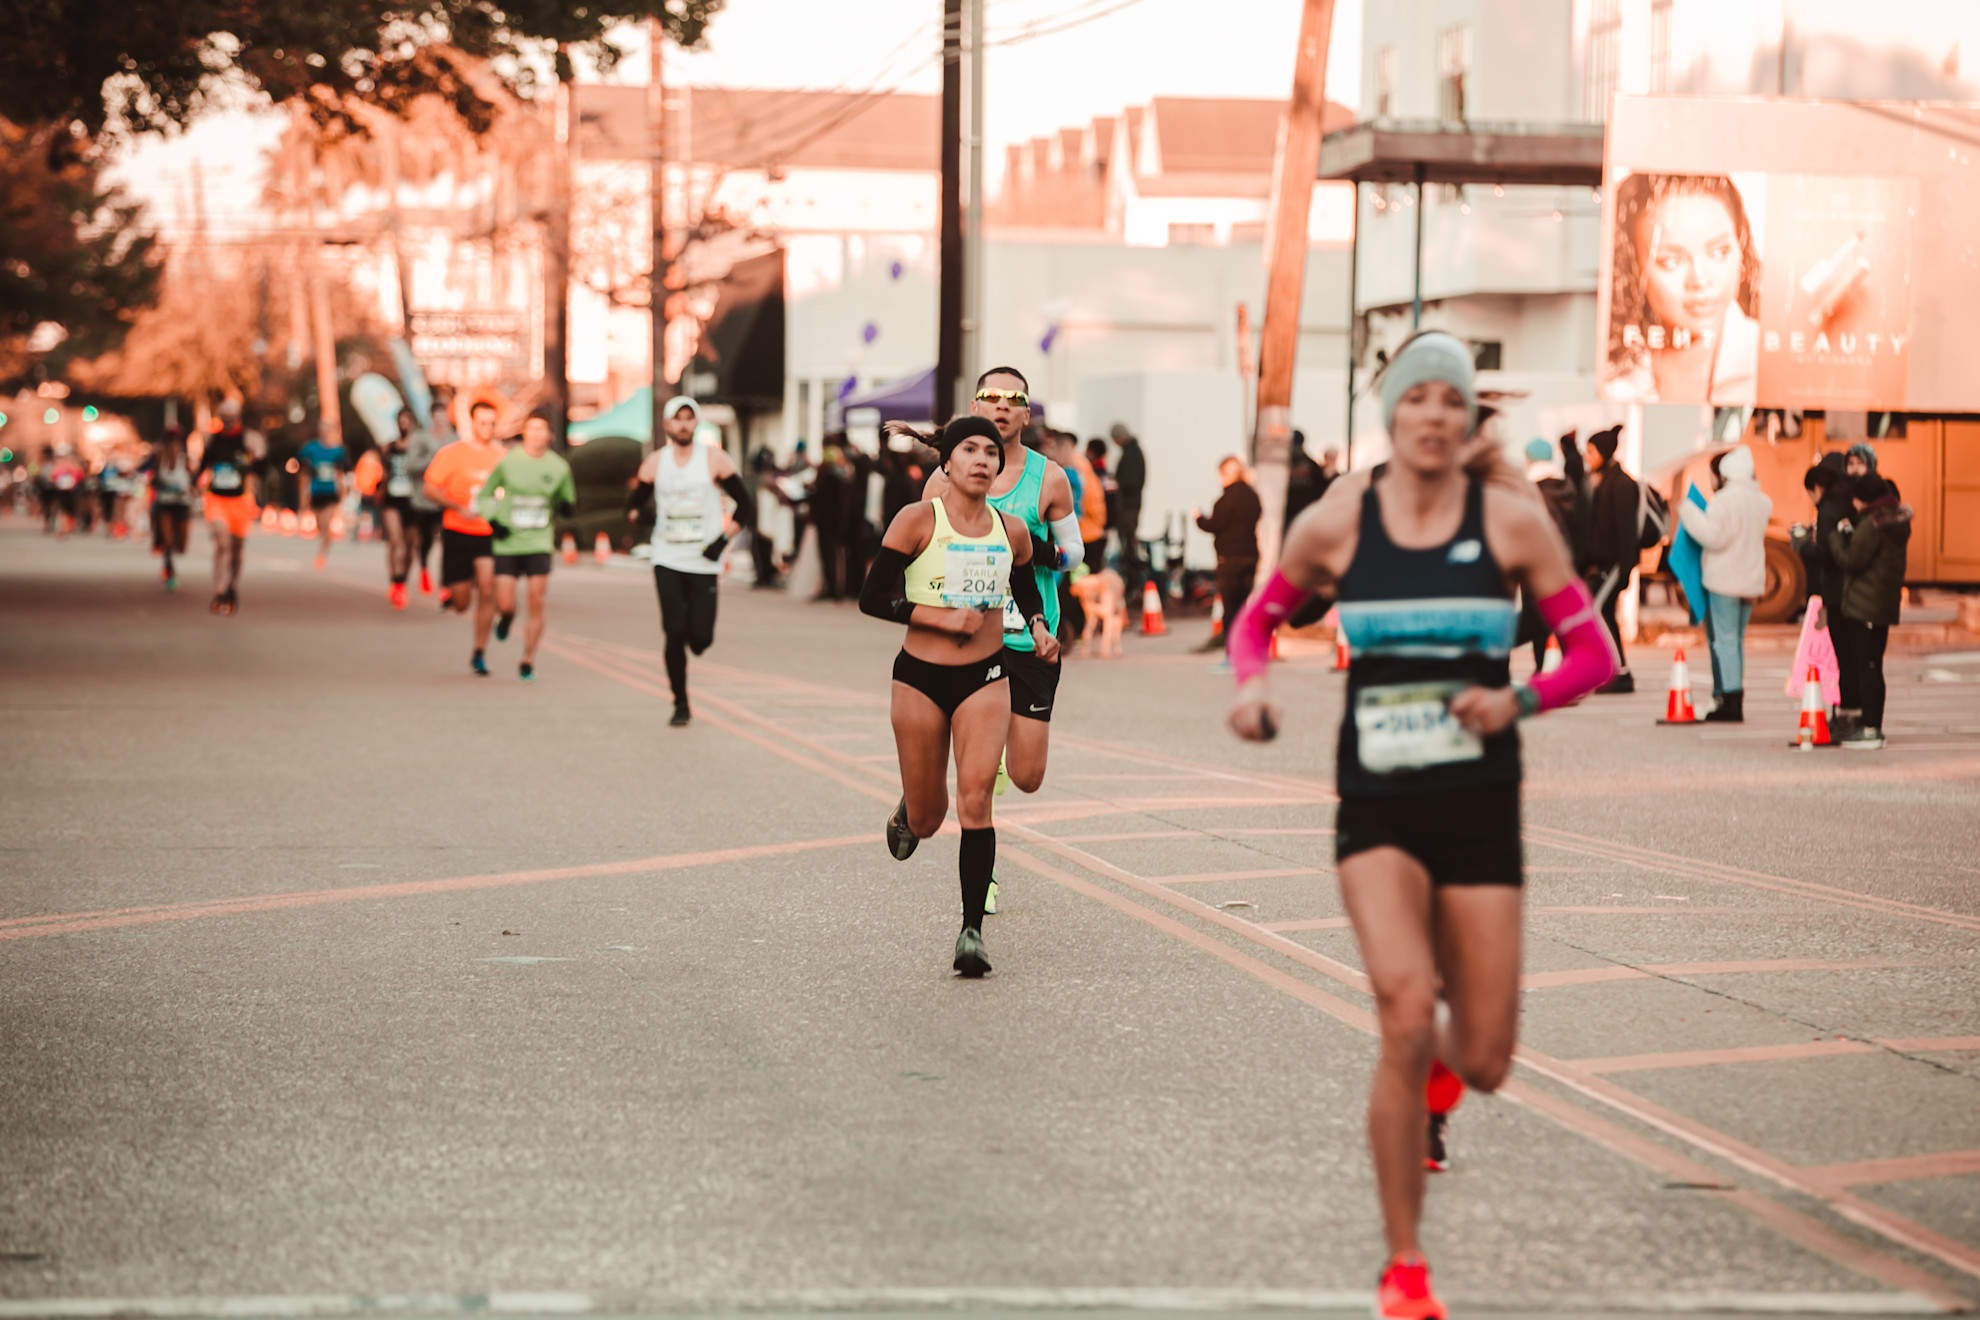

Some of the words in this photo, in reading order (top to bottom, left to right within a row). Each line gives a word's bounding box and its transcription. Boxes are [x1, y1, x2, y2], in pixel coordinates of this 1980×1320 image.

[1764, 330, 1906, 355] BEAUTY
[962, 568, 999, 578] STARLA
[961, 579, 996, 593] 204
